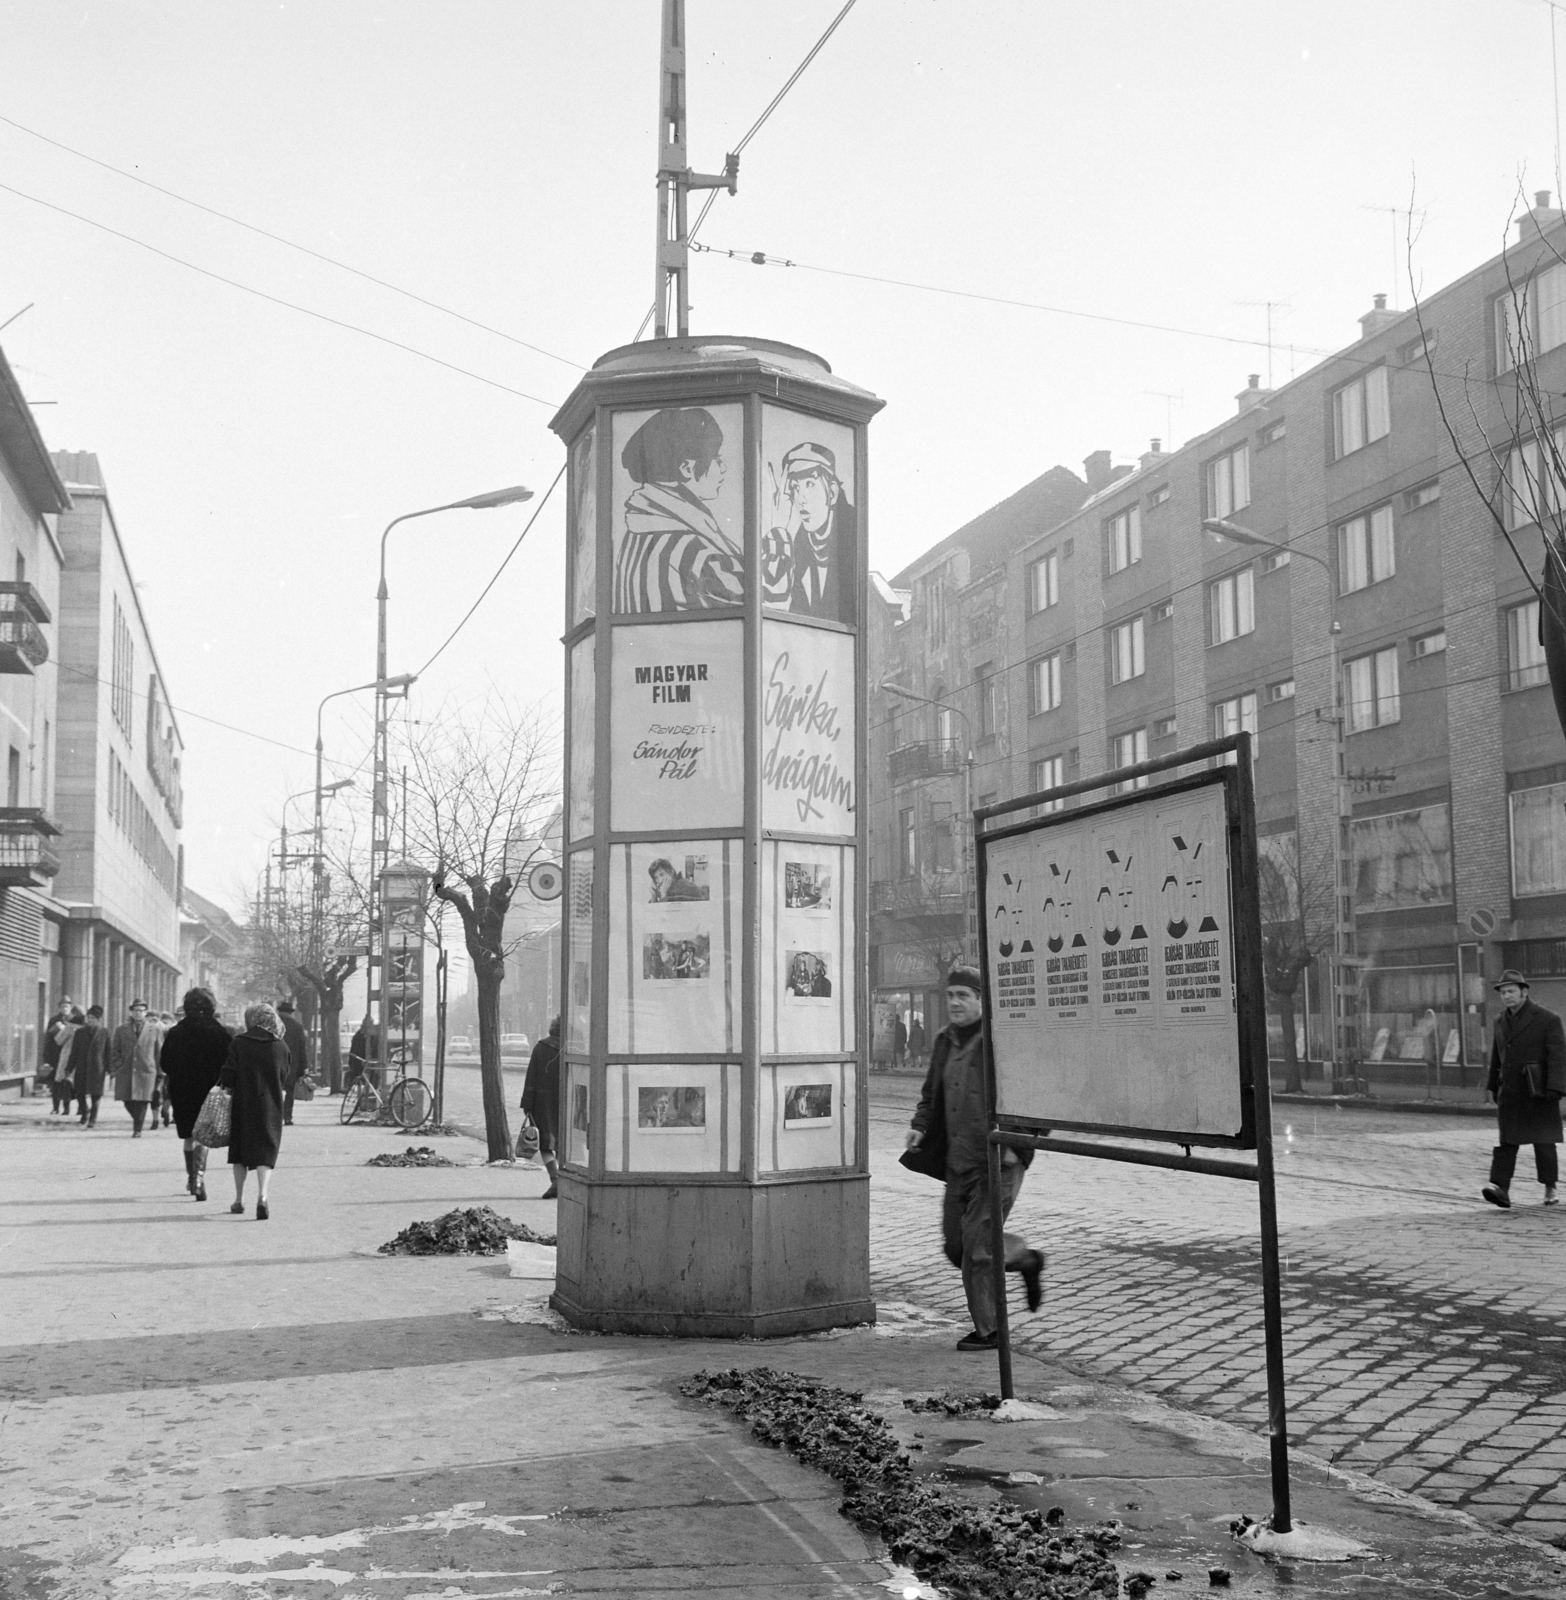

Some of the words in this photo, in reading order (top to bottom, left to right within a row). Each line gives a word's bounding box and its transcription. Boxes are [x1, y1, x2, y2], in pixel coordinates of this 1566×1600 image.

[635, 664, 708, 684] MAGYAR
[652, 685, 691, 703] FILM
[764, 651, 841, 742] Sárika,
[648, 724, 716, 735] RENDEZTE:
[633, 740, 703, 760] Sándor
[659, 759, 697, 779] Pál
[763, 727, 856, 822] drágám
